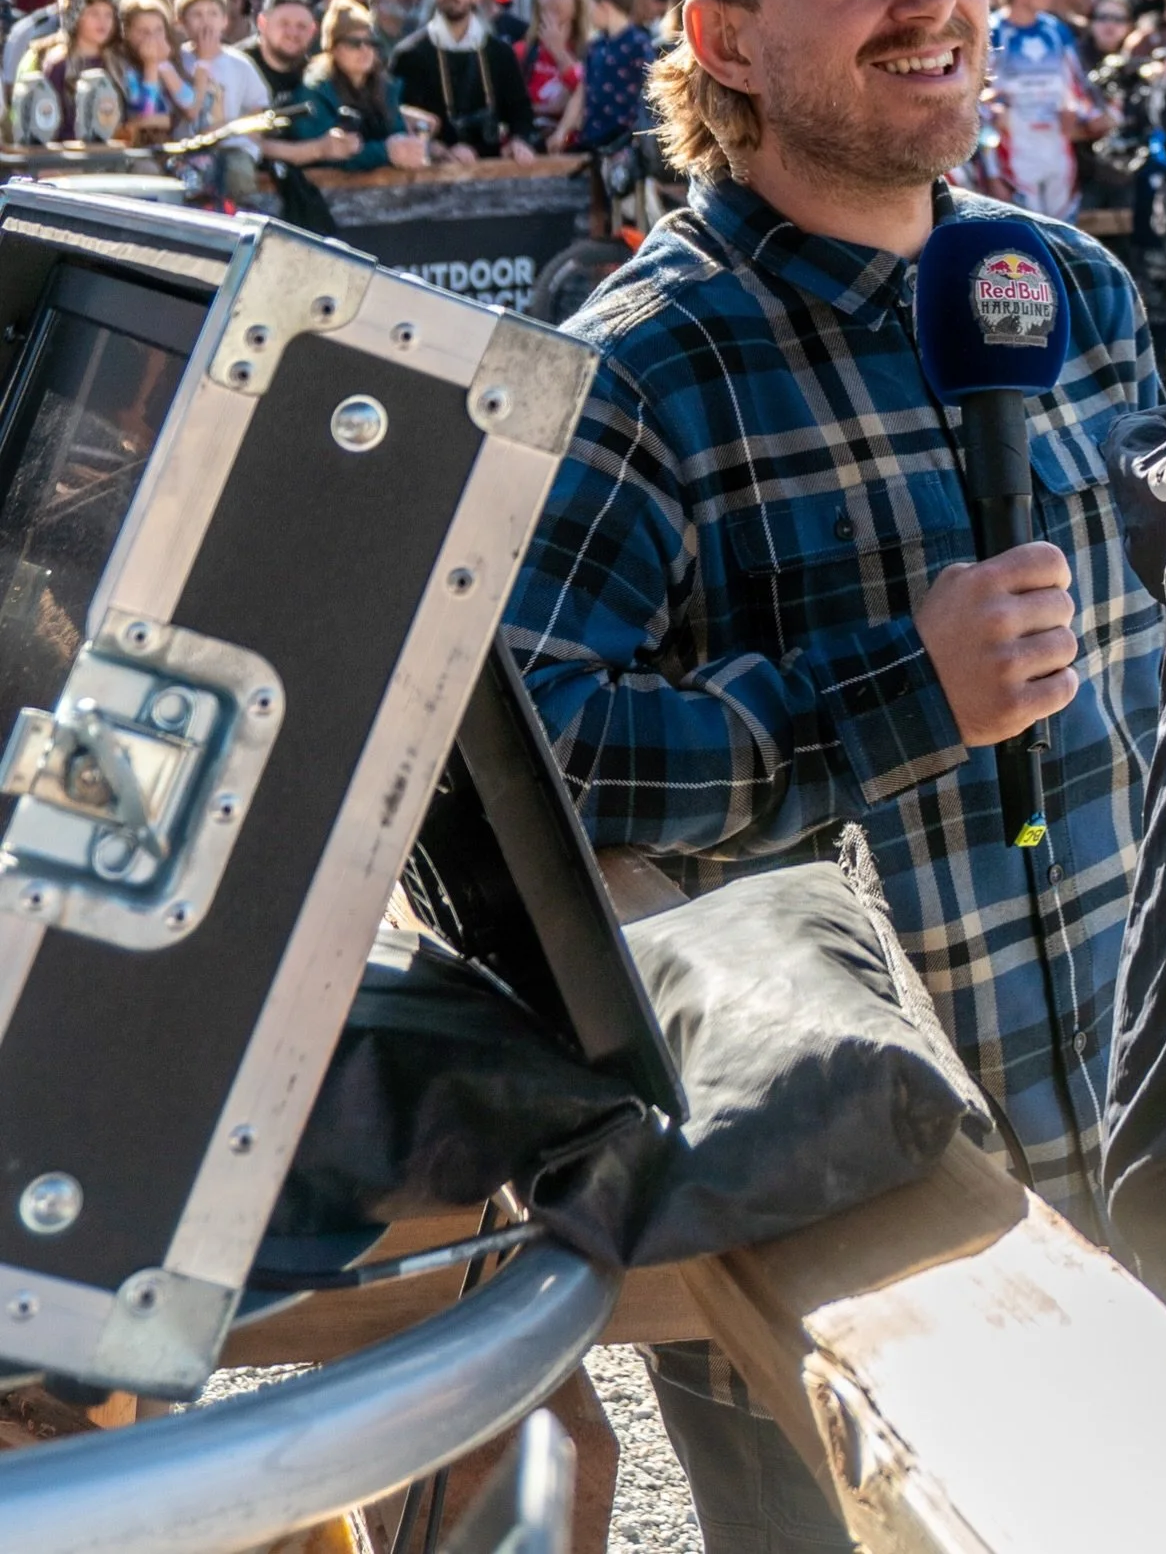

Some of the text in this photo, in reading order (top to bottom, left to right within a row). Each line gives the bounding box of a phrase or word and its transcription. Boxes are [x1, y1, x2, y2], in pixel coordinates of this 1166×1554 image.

[392, 257, 536, 291] UTDOOR
[979, 281, 1049, 301] Red Bull
[981, 301, 1051, 318] HARDLINE
